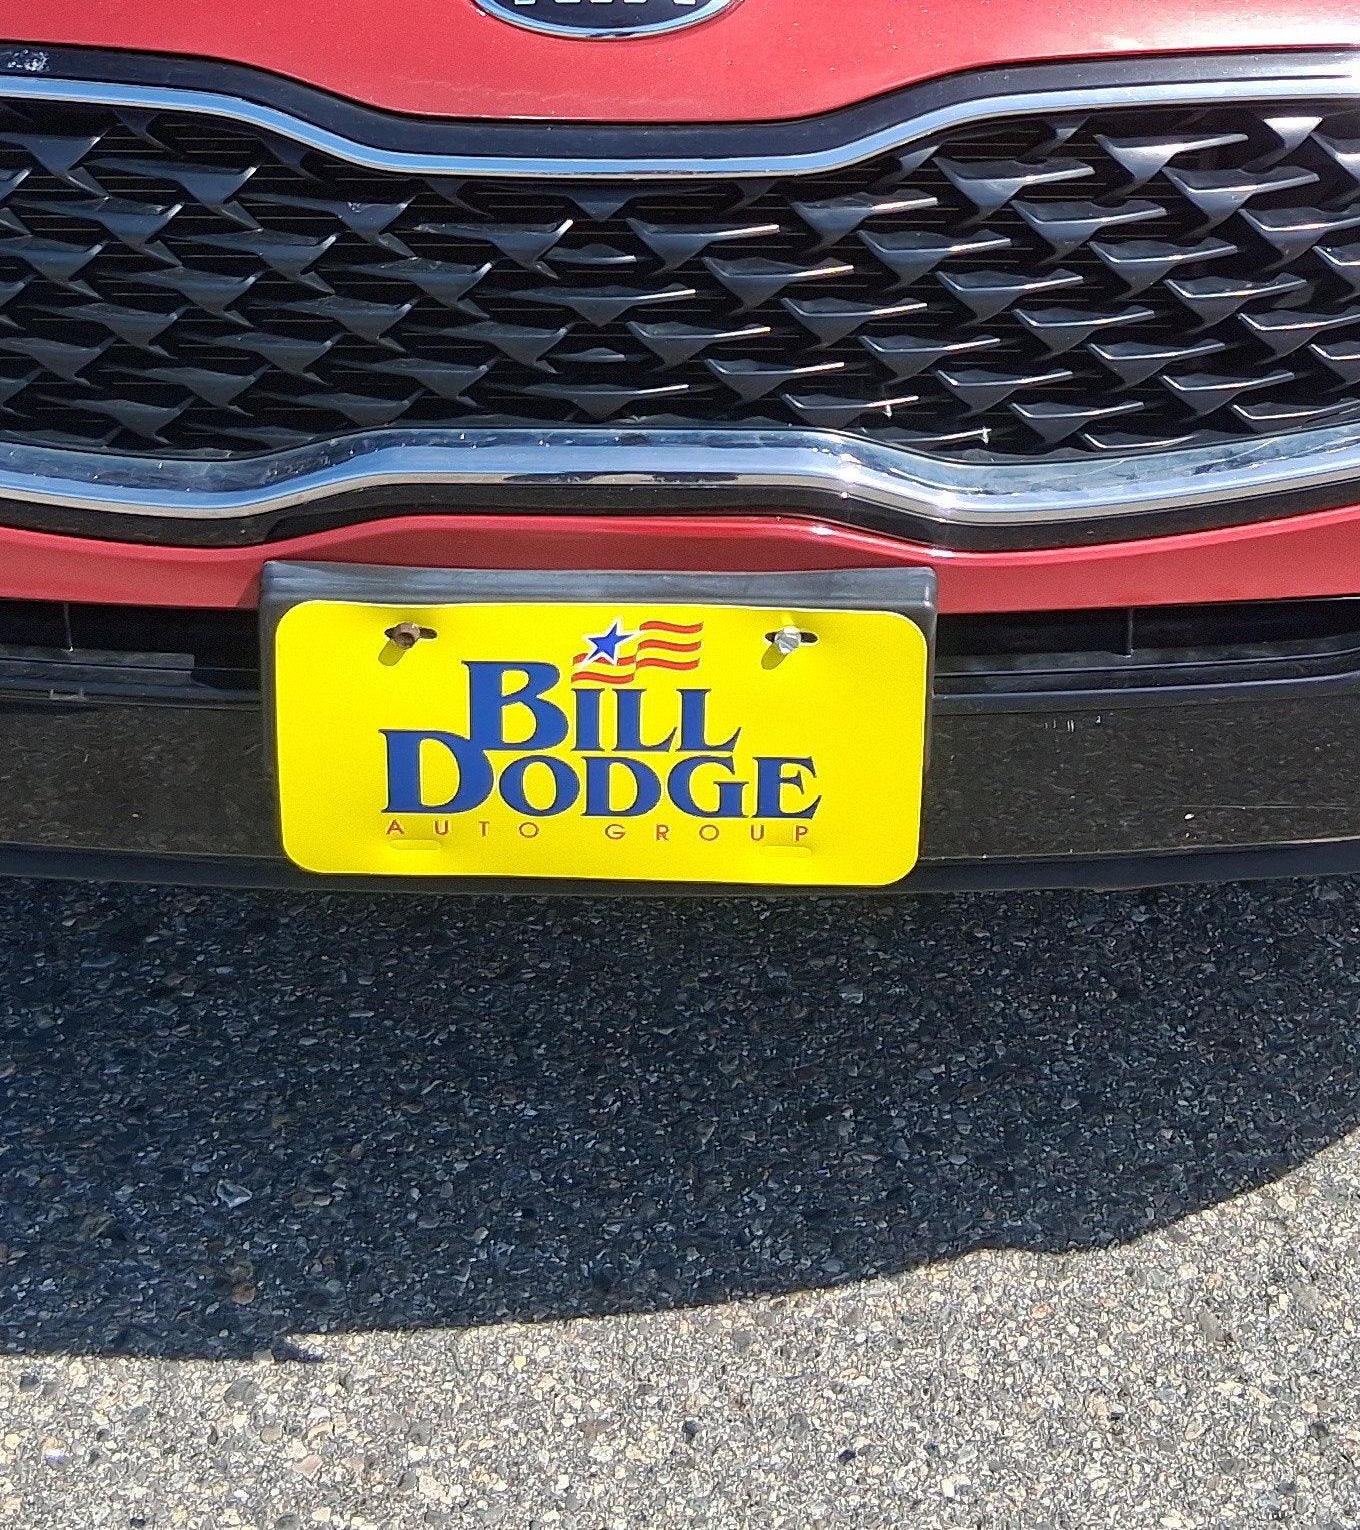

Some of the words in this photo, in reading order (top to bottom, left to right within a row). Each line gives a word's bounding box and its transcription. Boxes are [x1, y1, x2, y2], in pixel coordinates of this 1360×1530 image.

[461, 660, 741, 753] BILL
[378, 728, 822, 820] DODGE
[385, 819, 540, 840] AUTO
[604, 822, 810, 842] GROUP
